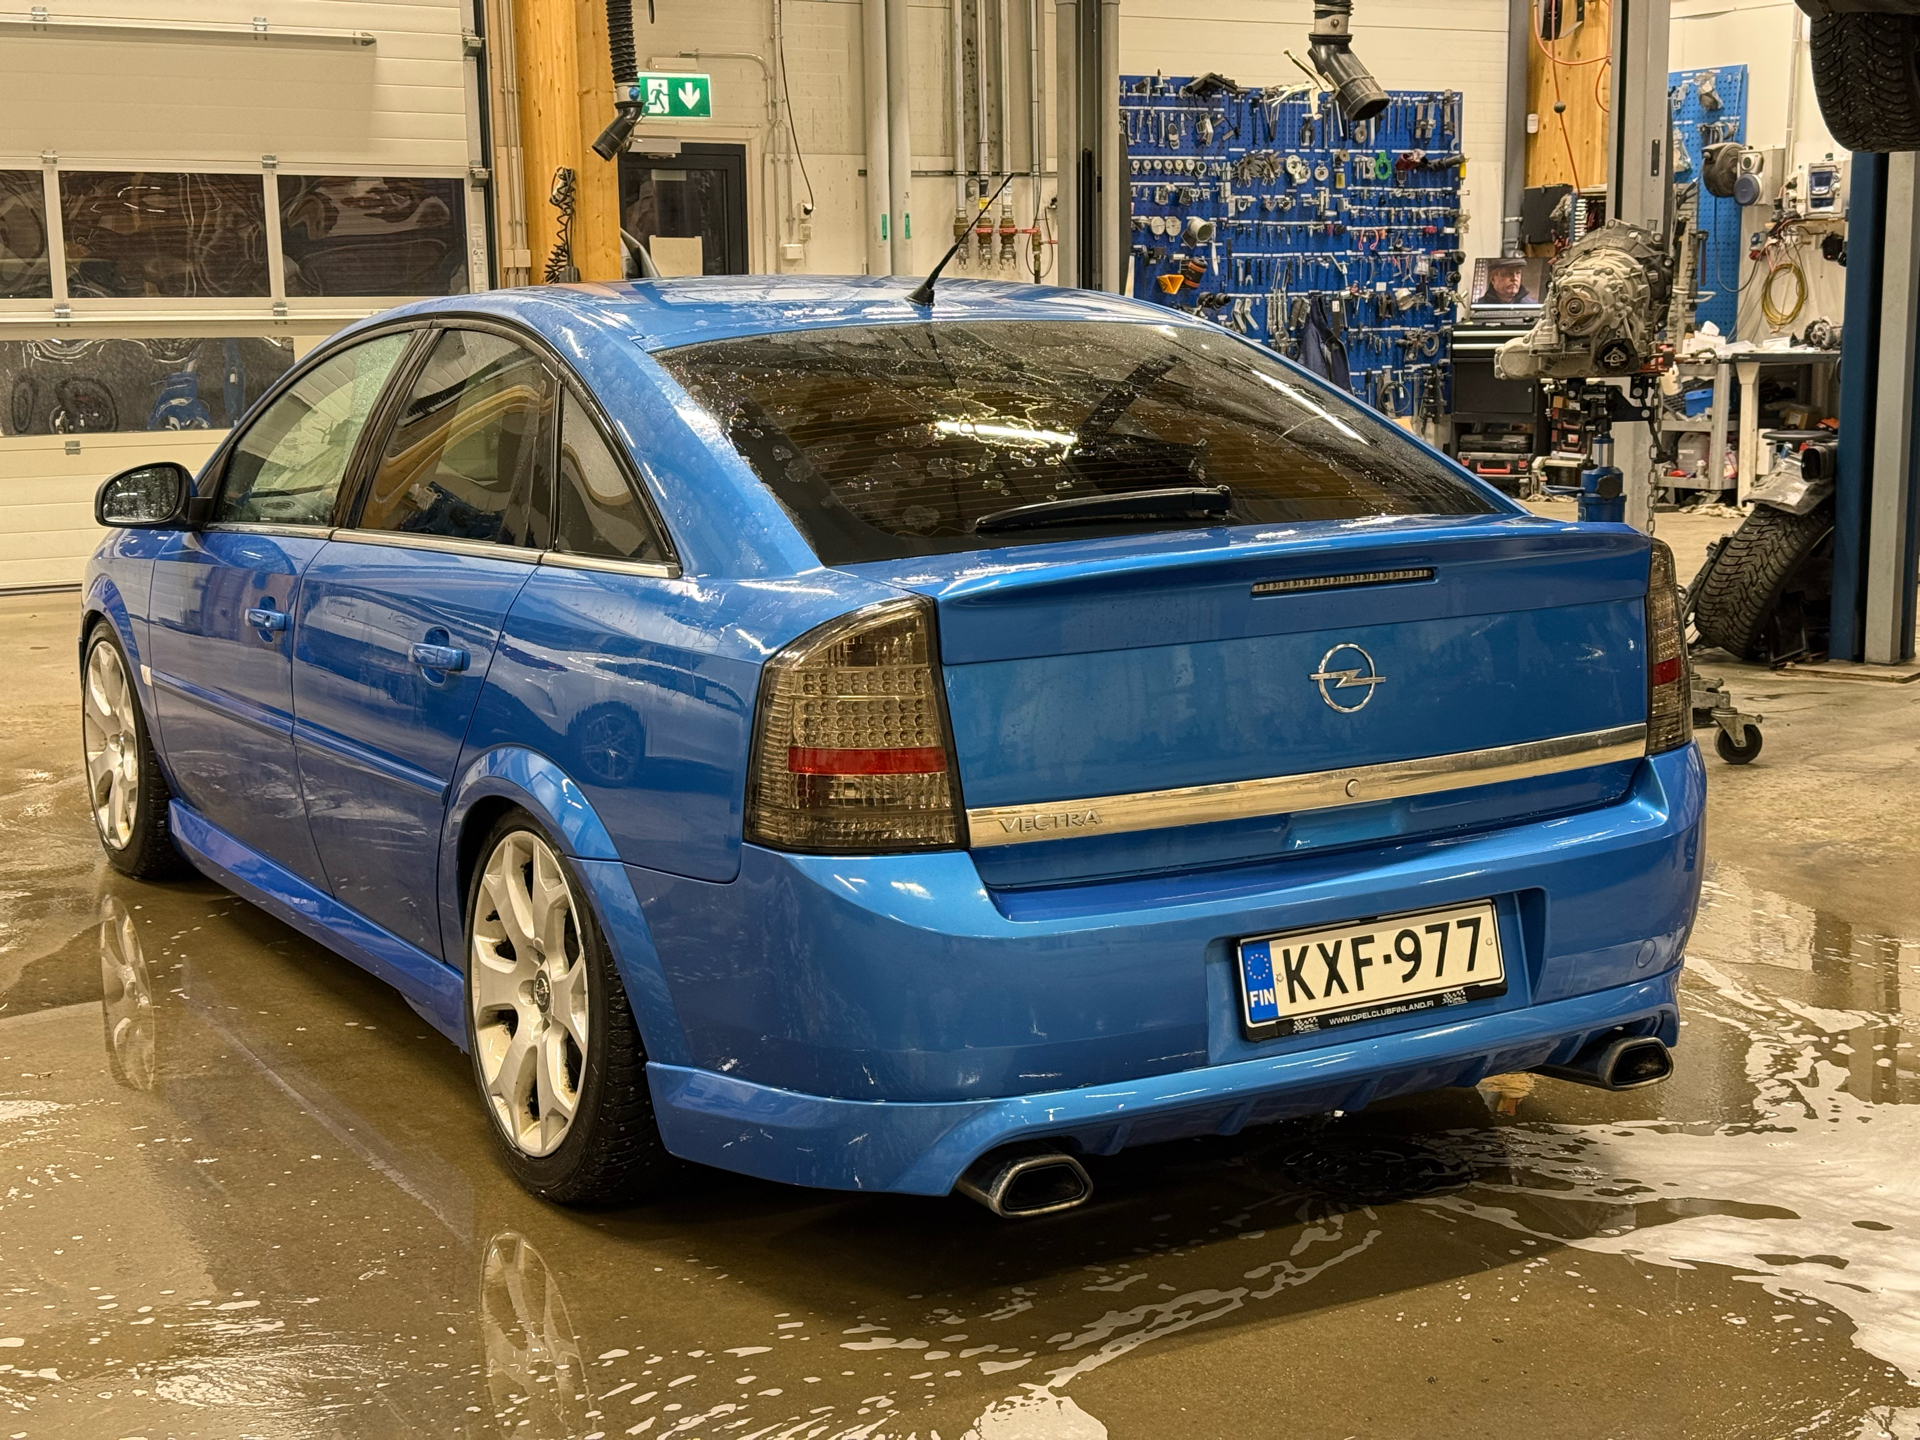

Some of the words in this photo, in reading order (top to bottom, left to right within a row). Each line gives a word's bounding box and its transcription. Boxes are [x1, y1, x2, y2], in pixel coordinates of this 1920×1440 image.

[998, 809, 1103, 833] VECTRA
[1283, 917, 1481, 1003] KXF-977
[1250, 988, 1274, 1008] FIN
[1329, 1000, 1434, 1025] WWW.OPELCLUBFINLAND.FI
